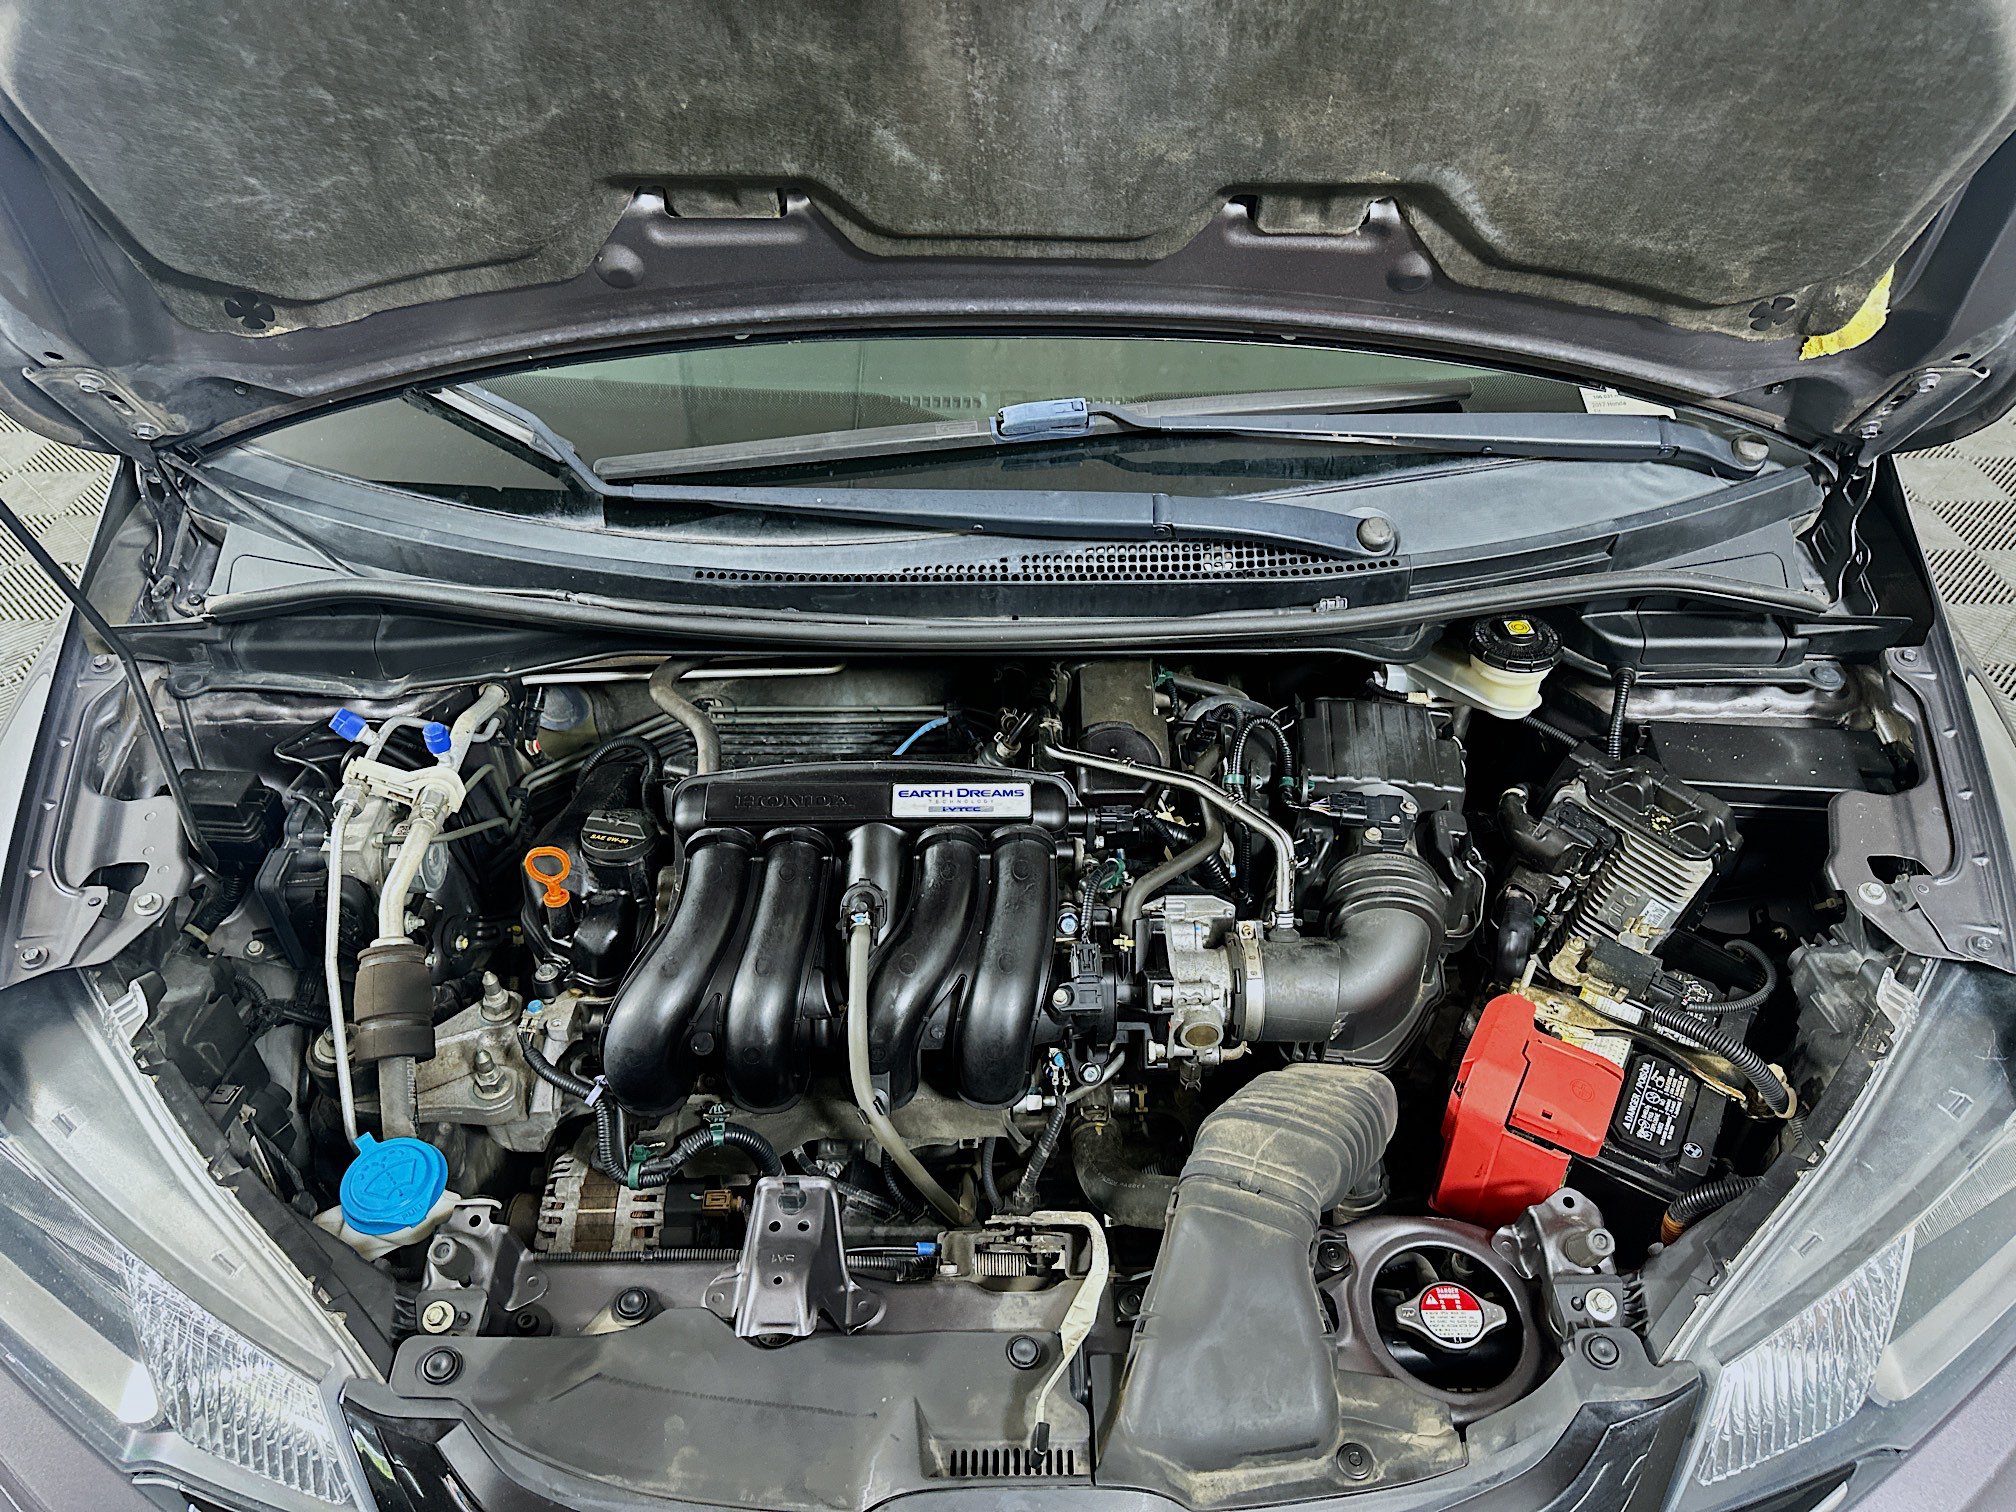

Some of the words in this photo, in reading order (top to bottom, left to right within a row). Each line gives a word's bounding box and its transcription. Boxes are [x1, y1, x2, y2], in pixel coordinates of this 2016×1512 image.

[734, 793, 856, 810] HONDA
[898, 789, 953, 798] EARTH
[956, 788, 1025, 798] DREAMS
[589, 833, 607, 841] SAE
[406, 1056, 417, 1104] NICHIRIN
[1624, 1092, 1641, 1123] DANGER
[1635, 1062, 1651, 1088] POISON
[401, 1203, 425, 1221] PULL
